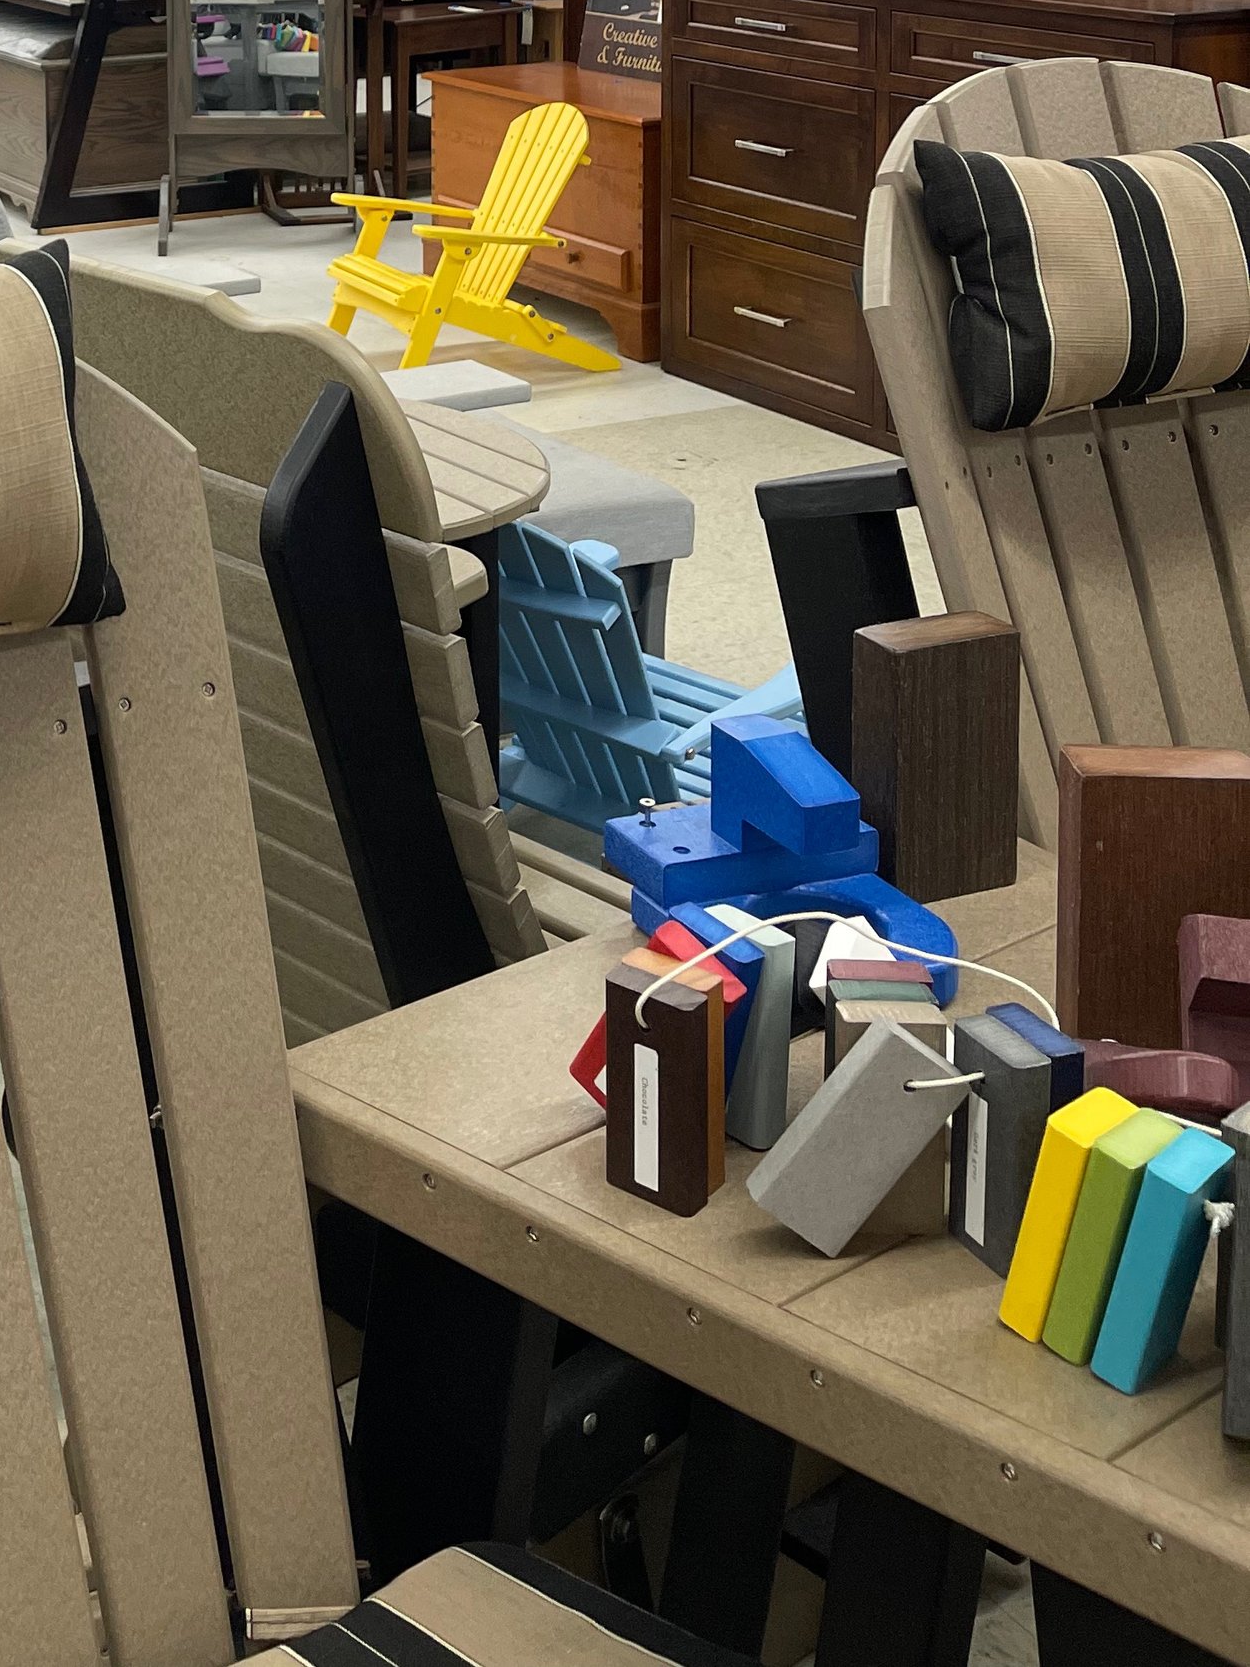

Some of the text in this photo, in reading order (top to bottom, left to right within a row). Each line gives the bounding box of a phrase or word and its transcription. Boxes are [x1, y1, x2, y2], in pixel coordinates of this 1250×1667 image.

[602, 22, 658, 49] Creative
[597, 45, 610, 64] &
[641, 1077, 649, 1126] Chocolate
